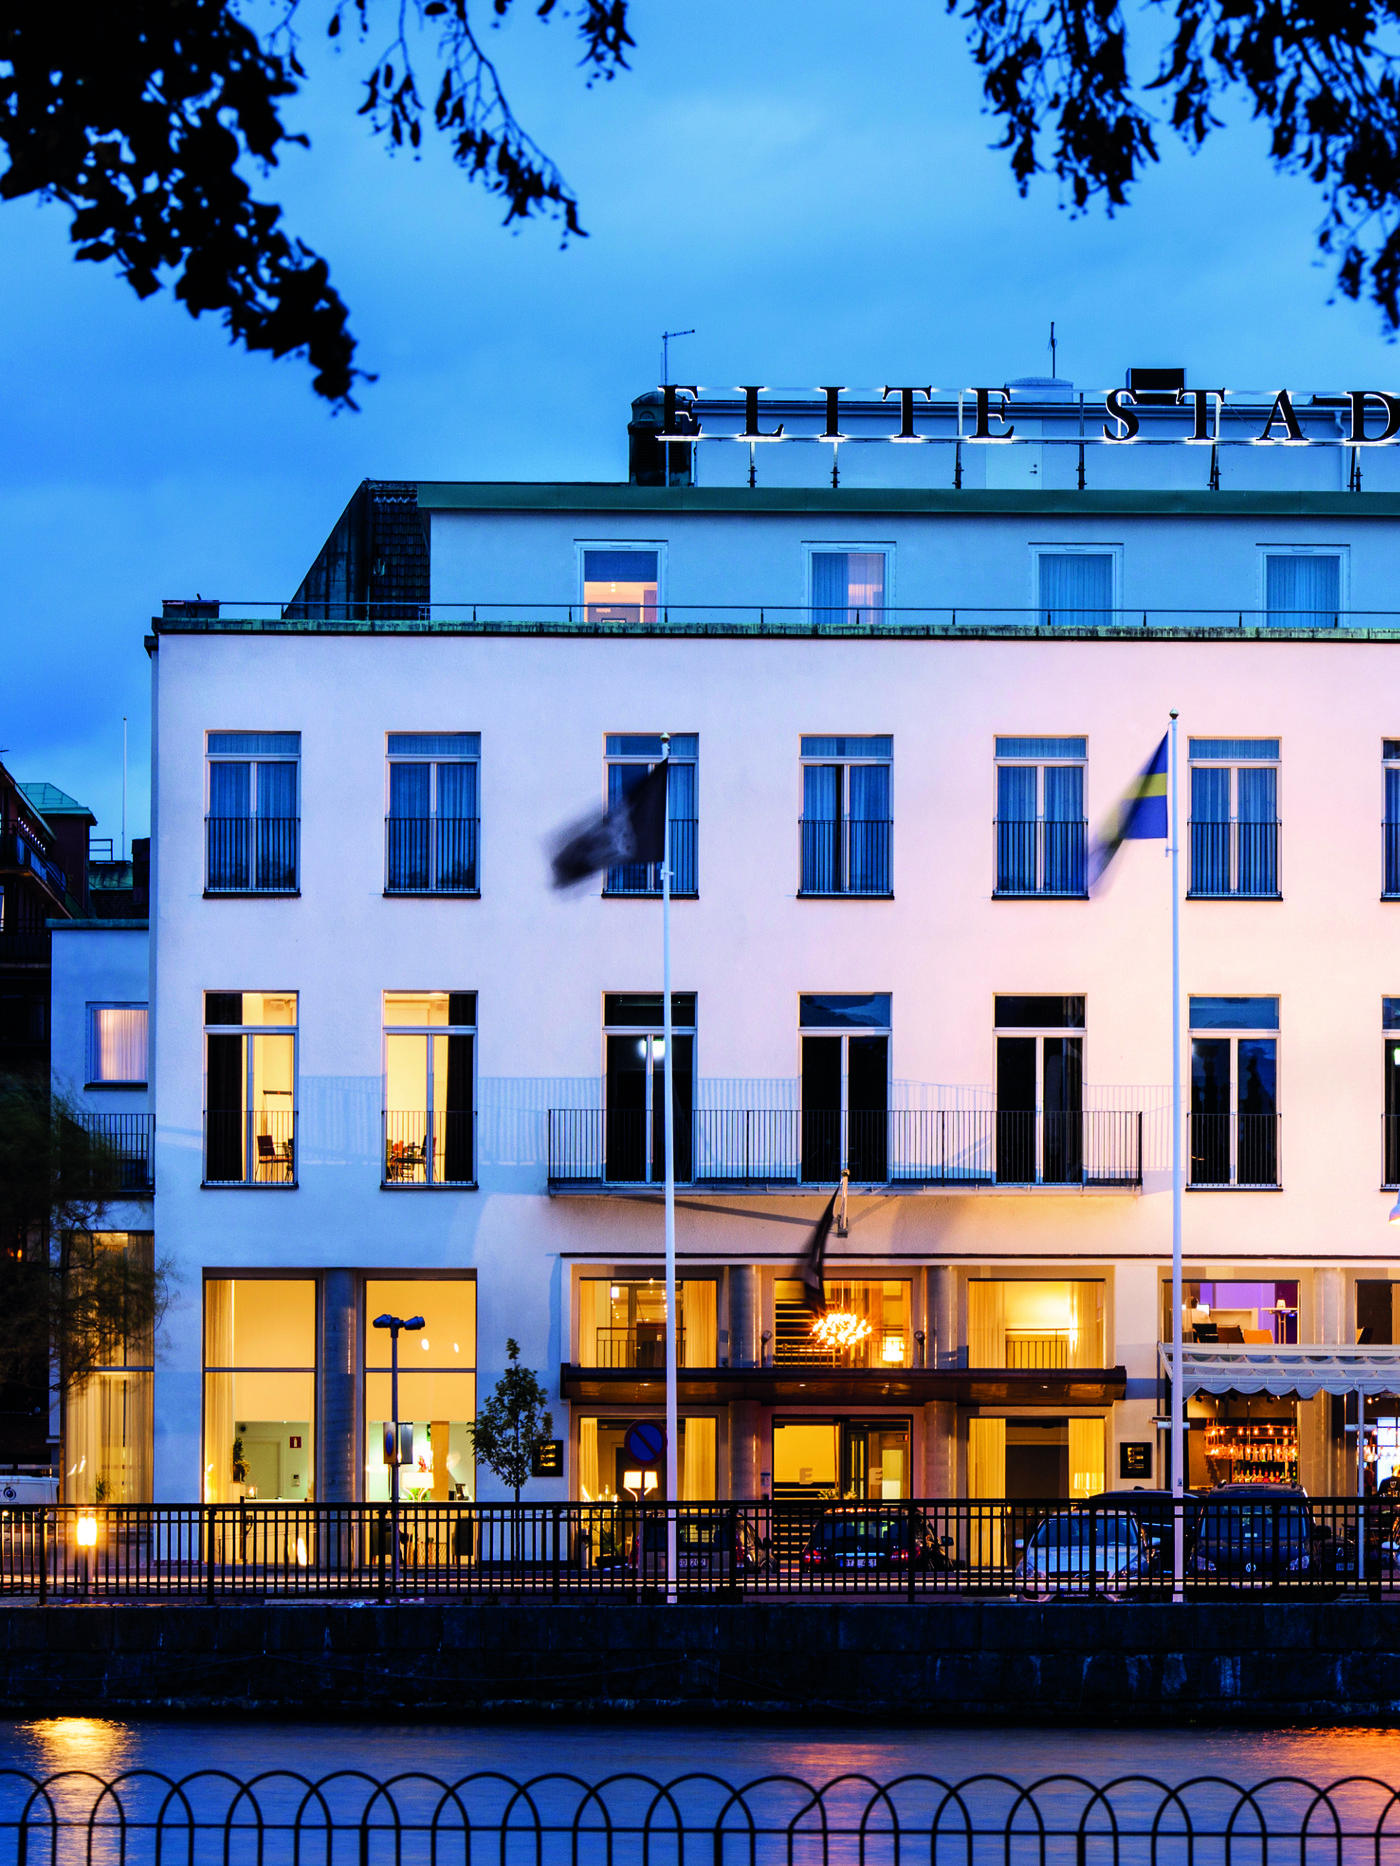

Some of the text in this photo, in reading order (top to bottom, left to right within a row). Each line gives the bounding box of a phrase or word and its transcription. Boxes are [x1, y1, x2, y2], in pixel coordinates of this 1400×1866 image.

[656, 385, 1015, 441] ELITE
[1127, 1447, 1145, 1469] E
[799, 1467, 813, 1485] E
